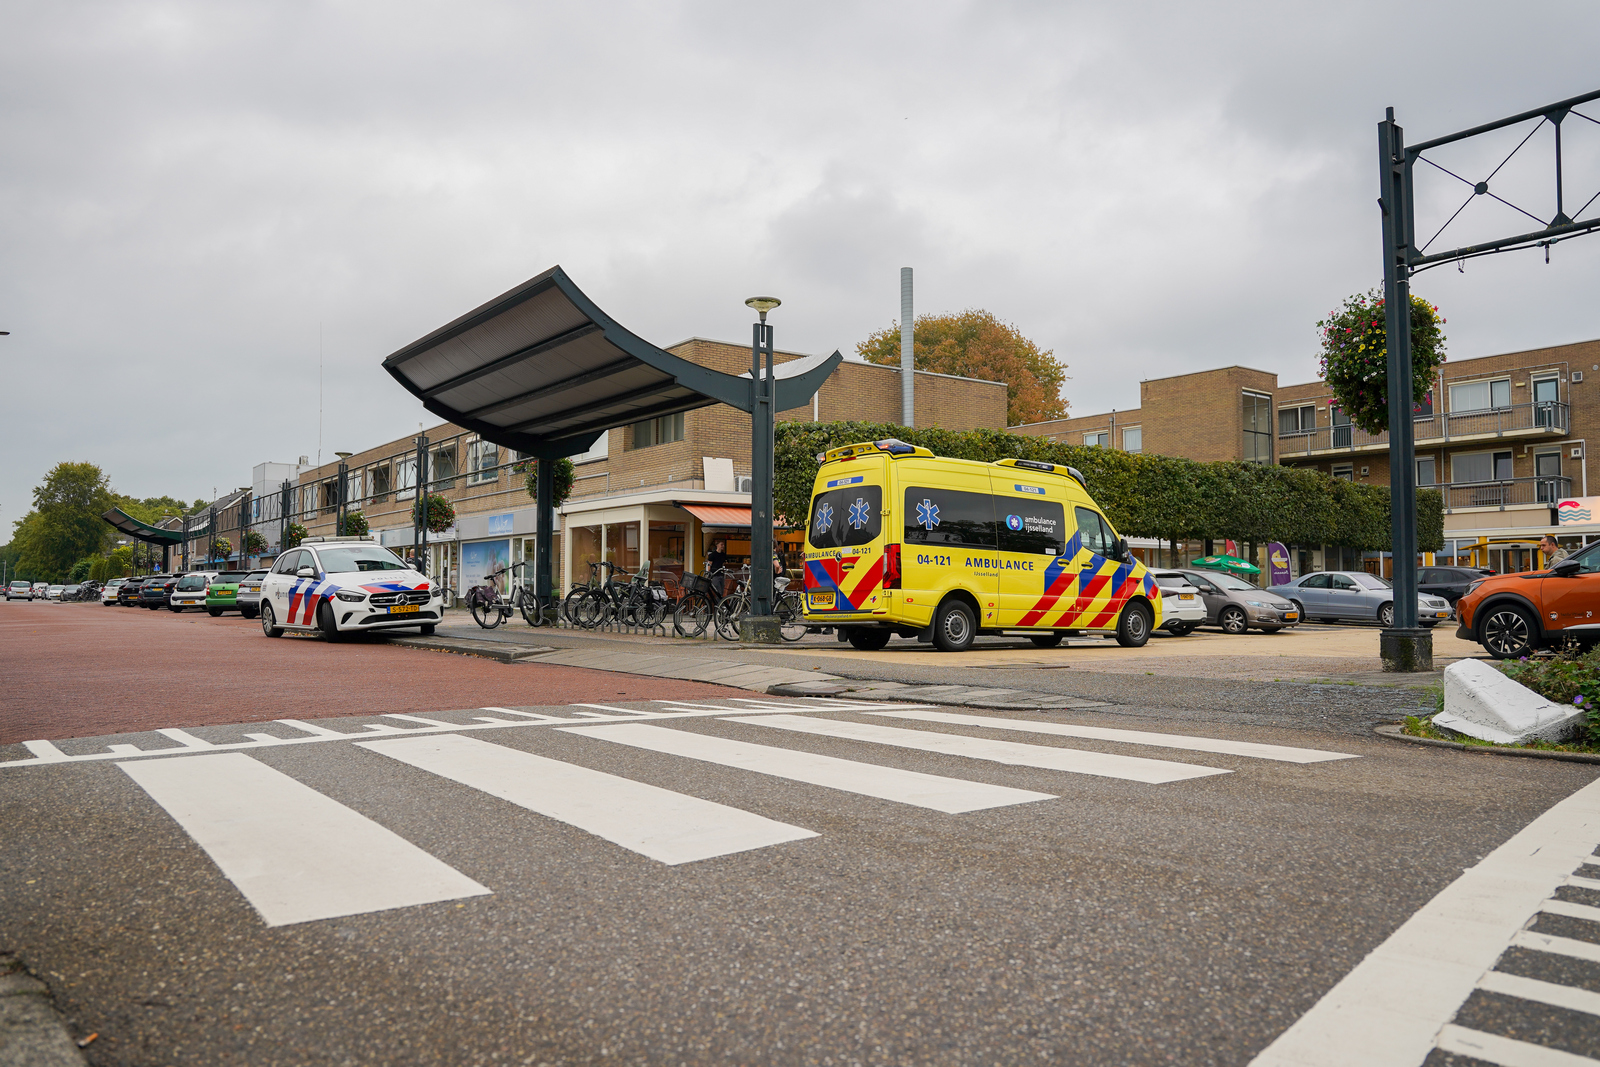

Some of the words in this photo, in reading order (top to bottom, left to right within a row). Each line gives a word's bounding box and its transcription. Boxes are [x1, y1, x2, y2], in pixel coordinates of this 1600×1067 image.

[1024, 516, 1057, 526] ambulance
[1024, 523, 1054, 534] ijsselland
[805, 550, 836, 559] AMBULANCE
[852, 547, 871, 555] 04-121
[917, 554, 951, 566] 04-121
[965, 557, 1034, 571] AMBULANCE
[392, 605, 418, 613] S-572-TD
